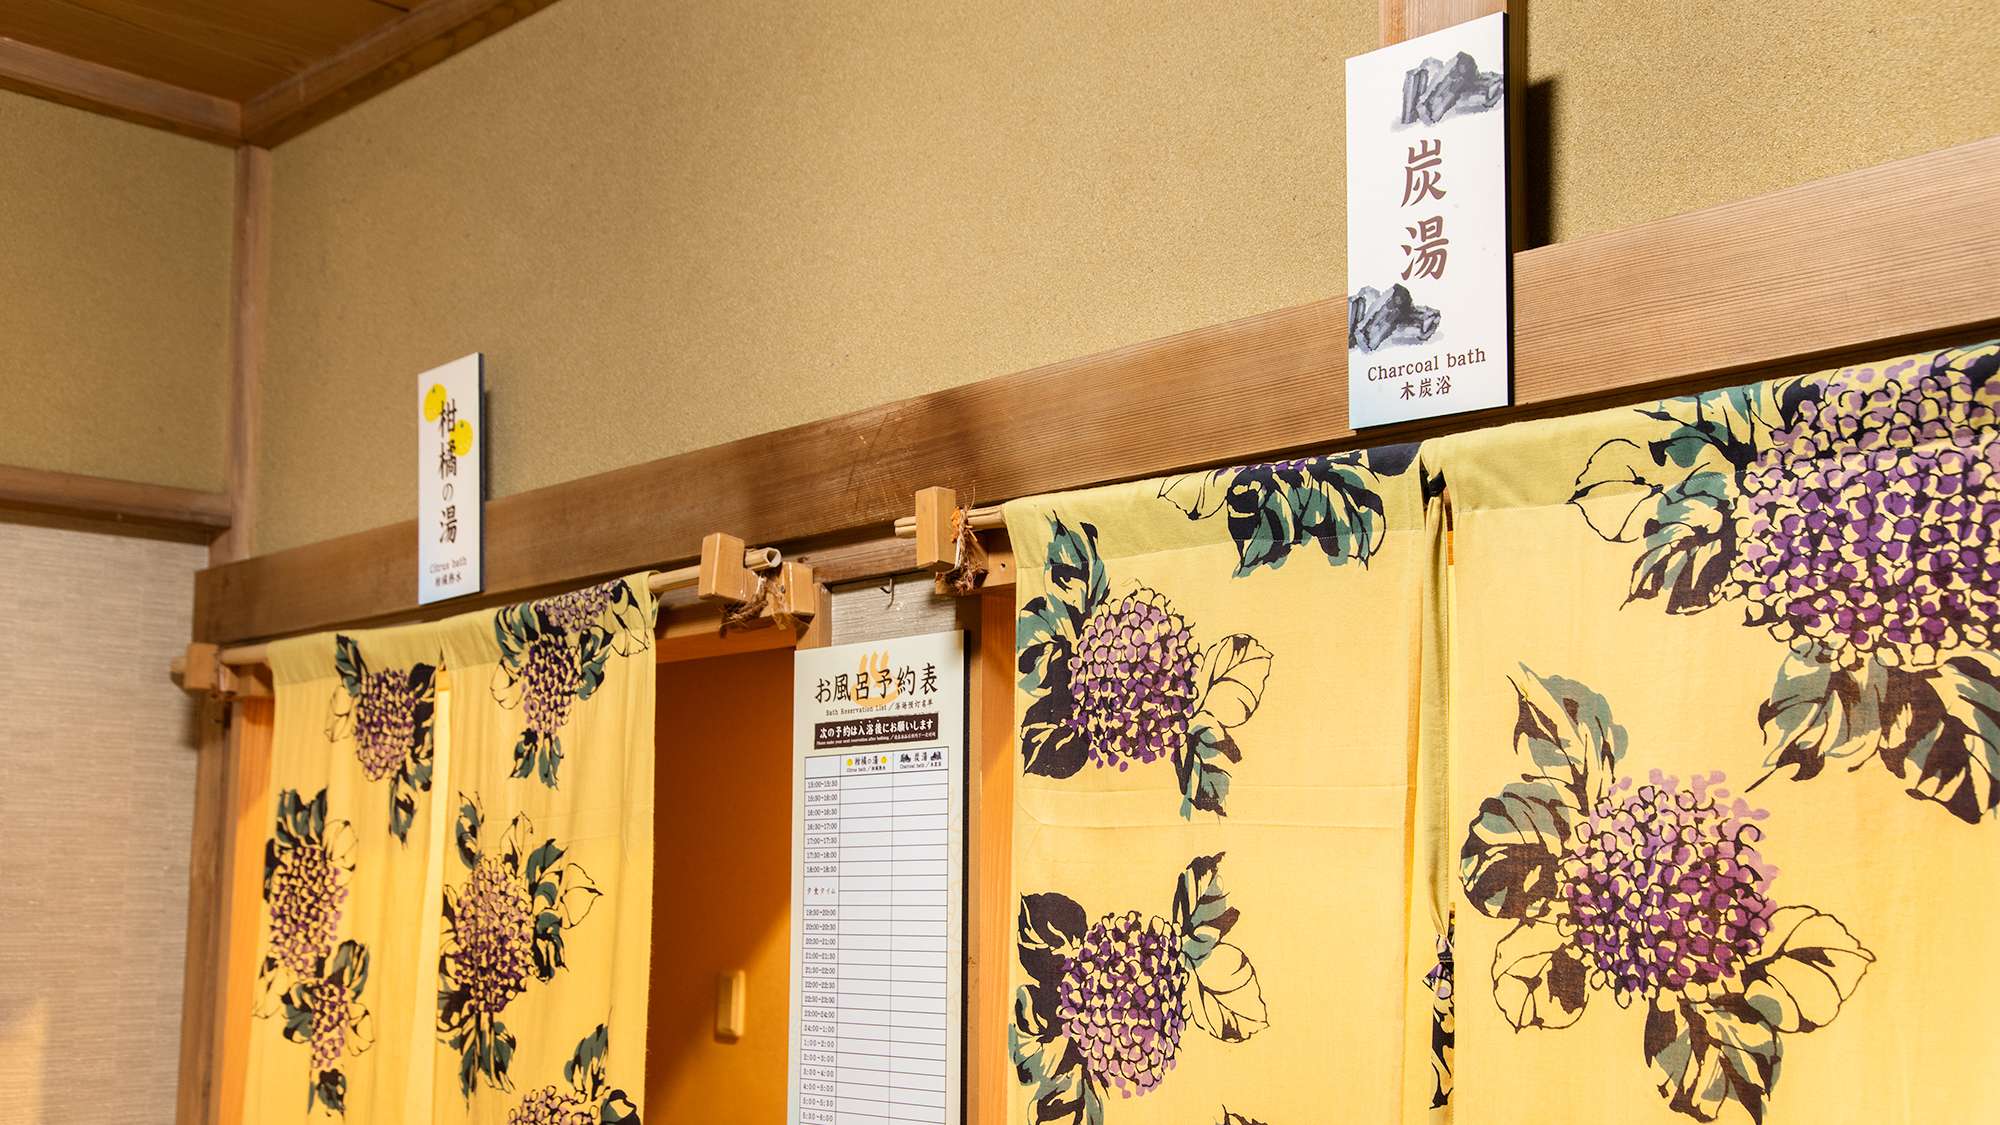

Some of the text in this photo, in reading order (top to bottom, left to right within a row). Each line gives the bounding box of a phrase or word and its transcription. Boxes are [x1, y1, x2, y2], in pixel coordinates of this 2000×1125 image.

[1400, 138, 1450, 282] 炭湯
[1367, 347, 1487, 382] Charcoal bath
[1399, 375, 1452, 401] 木炭浴
[438, 398, 458, 544] 柑橘の湯
[429, 556, 467, 574] Citrus bath
[814, 662, 939, 704] お風呂予約表
[825, 709, 839, 717] Bath
[840, 705, 874, 715] Reservation
[875, 704, 887, 712] List
[819, 719, 934, 740] 次の予約は入浴後にお願いします
